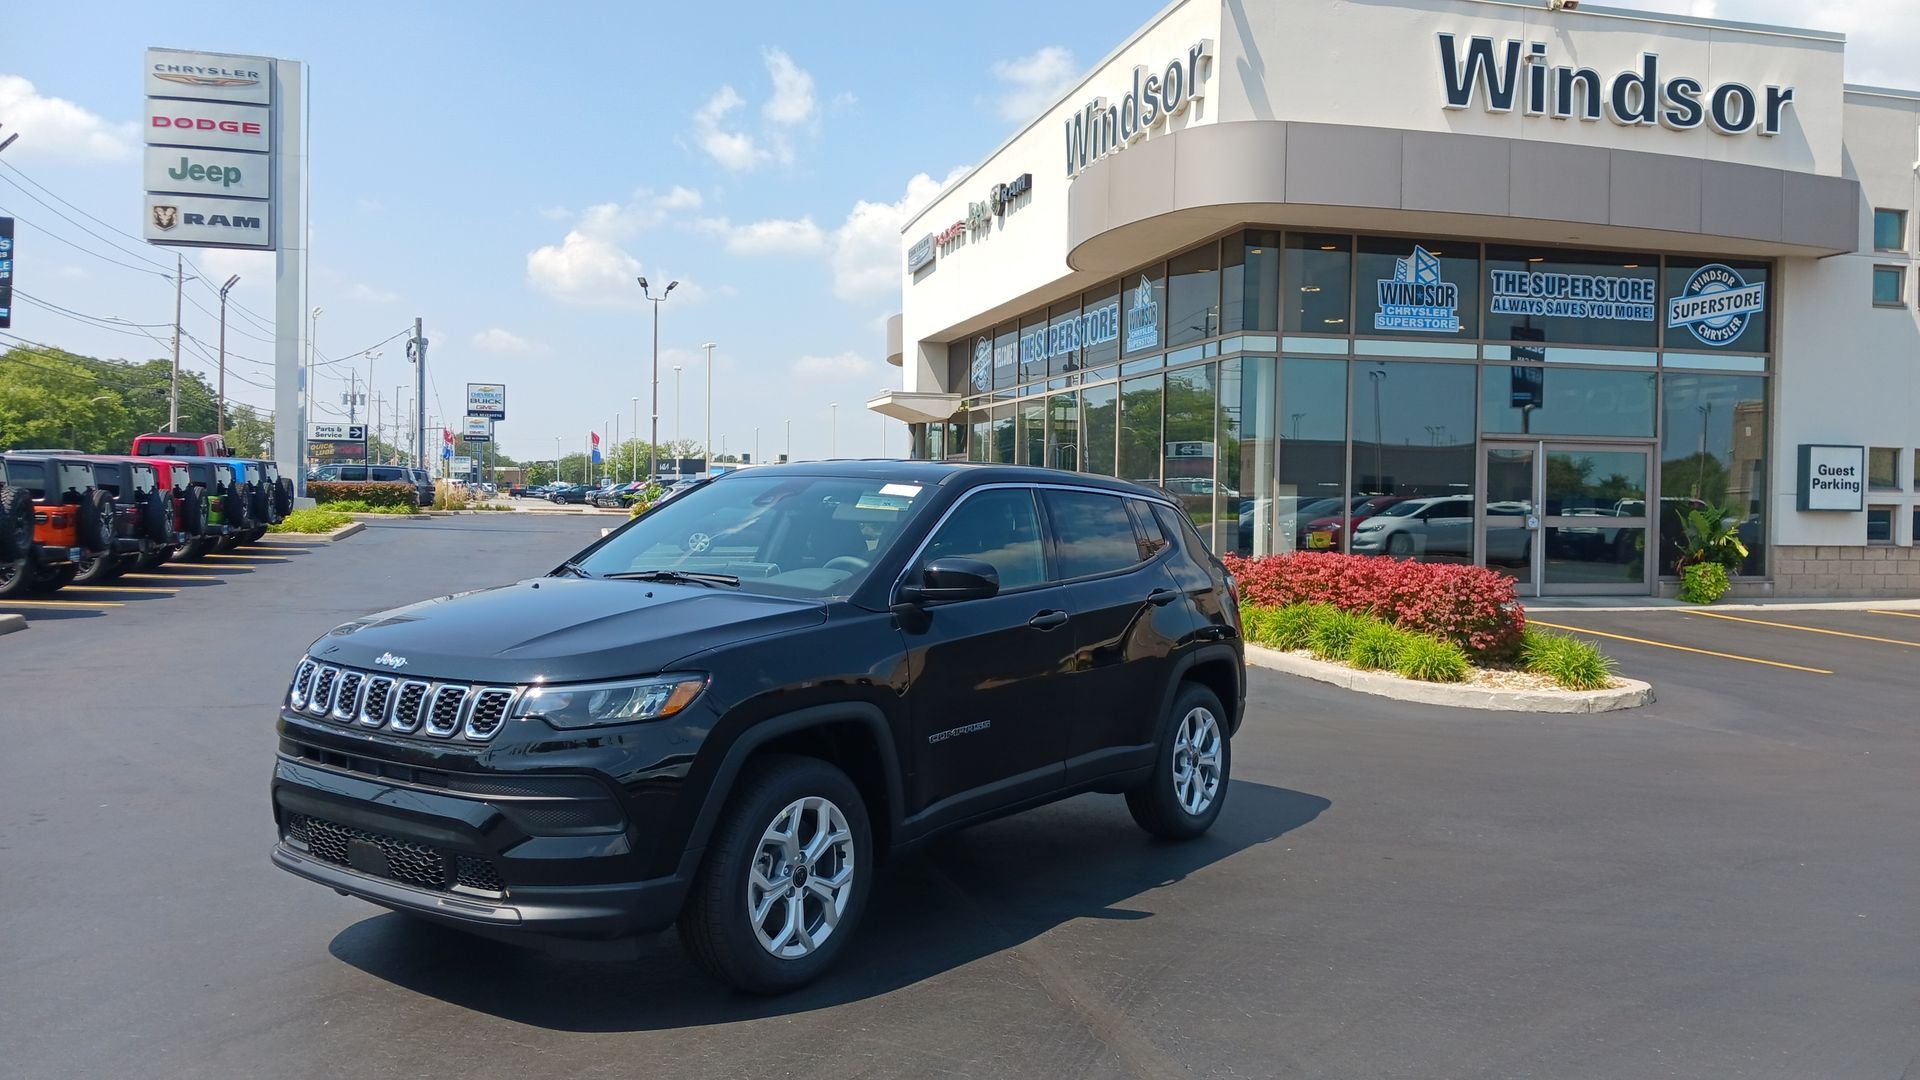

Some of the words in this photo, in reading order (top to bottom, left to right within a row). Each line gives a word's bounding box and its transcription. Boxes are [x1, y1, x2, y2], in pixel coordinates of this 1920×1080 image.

[154, 63, 259, 79] CHRYSLER
[1437, 33, 1794, 135] Windsor
[1065, 41, 1207, 177] Windsor
[152, 116, 261, 134] DODGE
[168, 157, 242, 187] Jeep
[183, 213, 260, 229] RAM
[1493, 272, 1529, 294] THE
[1531, 275, 1653, 300] SUPERSTORE
[1691, 270, 1736, 292] WINDSOR
[1380, 282, 1456, 308] WINDSOR
[1672, 291, 1761, 320] SUPERSTORE
[1387, 306, 1448, 317] CHRYSLER
[1493, 298, 1543, 314] ALWAYS
[1546, 301, 1586, 316] SAVES
[1589, 303, 1613, 317] YOU
[1615, 304, 1653, 319] MORE!
[1378, 316, 1458, 329] SUPERSTORE
[1698, 317, 1742, 341] CHRYSLER
[1021, 334, 1034, 364] THE
[1035, 305, 1117, 360] SUPERSTORE
[311, 443, 335, 451] QUICK
[1818, 464, 1855, 476] Guest
[1812, 478, 1860, 492] Parking
[375, 652, 406, 669] Jeep
